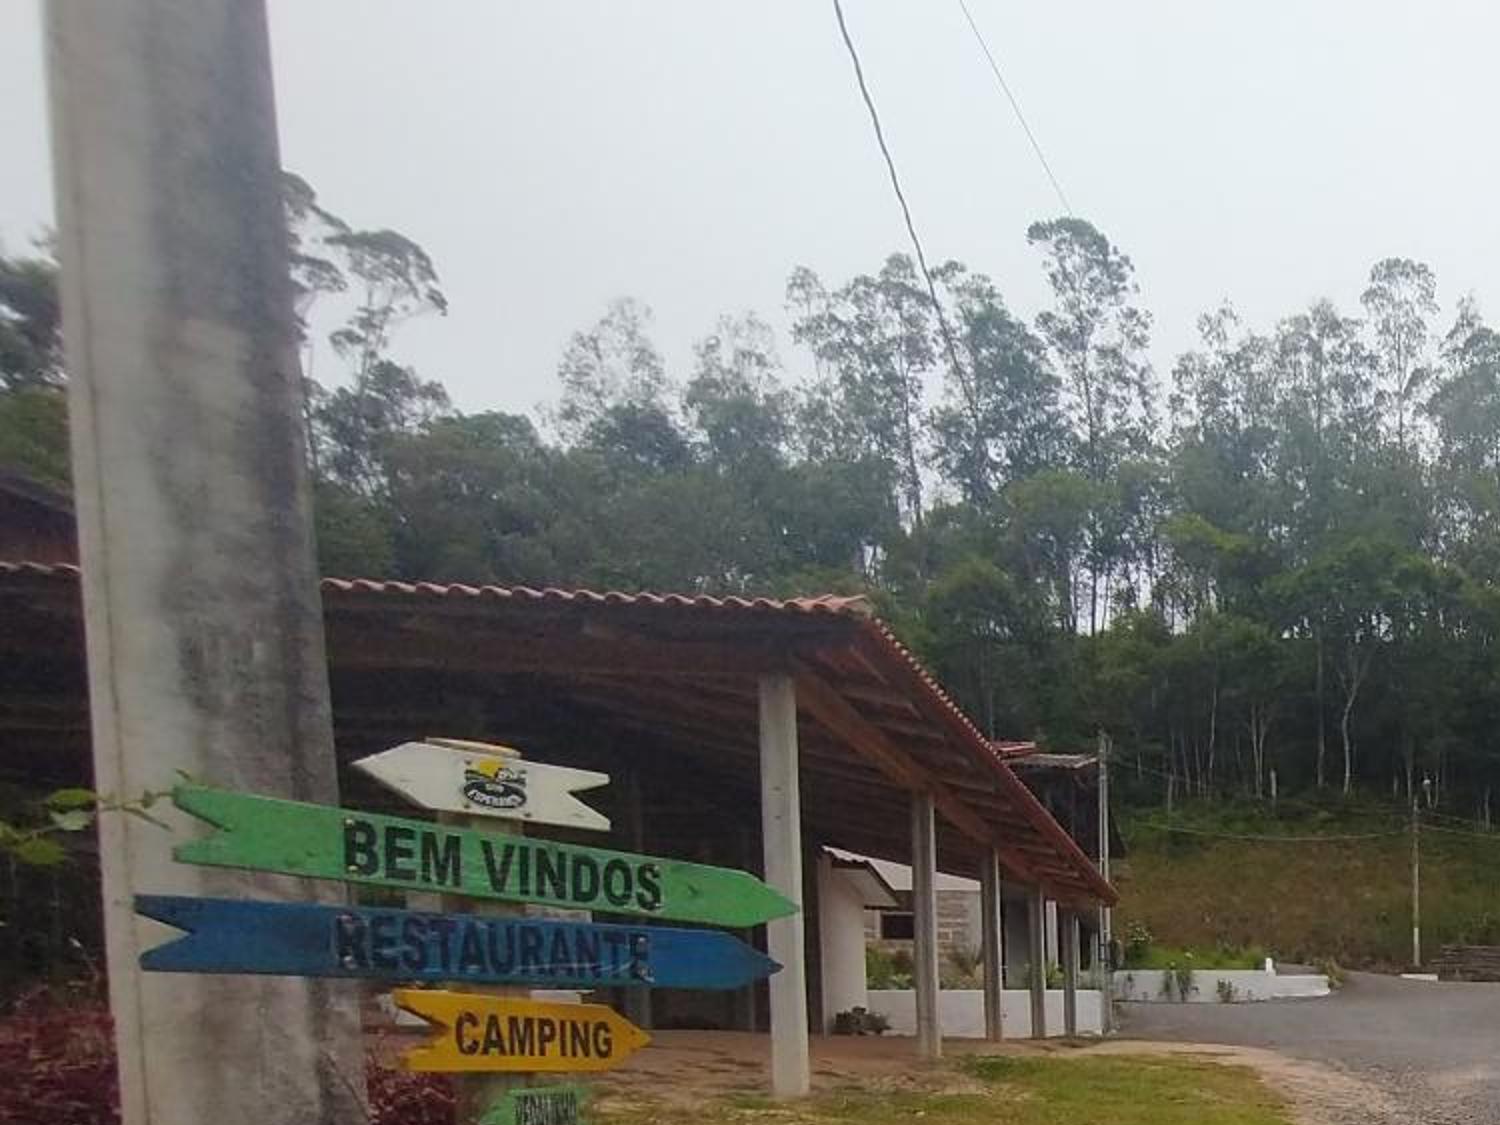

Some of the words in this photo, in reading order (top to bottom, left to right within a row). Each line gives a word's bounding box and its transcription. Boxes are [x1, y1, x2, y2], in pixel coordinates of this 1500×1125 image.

[344, 819, 461, 887] BEM
[480, 838, 662, 912] VINDOS
[335, 912, 653, 981] RESTAURANTE
[456, 1011, 613, 1058] CAMPING
